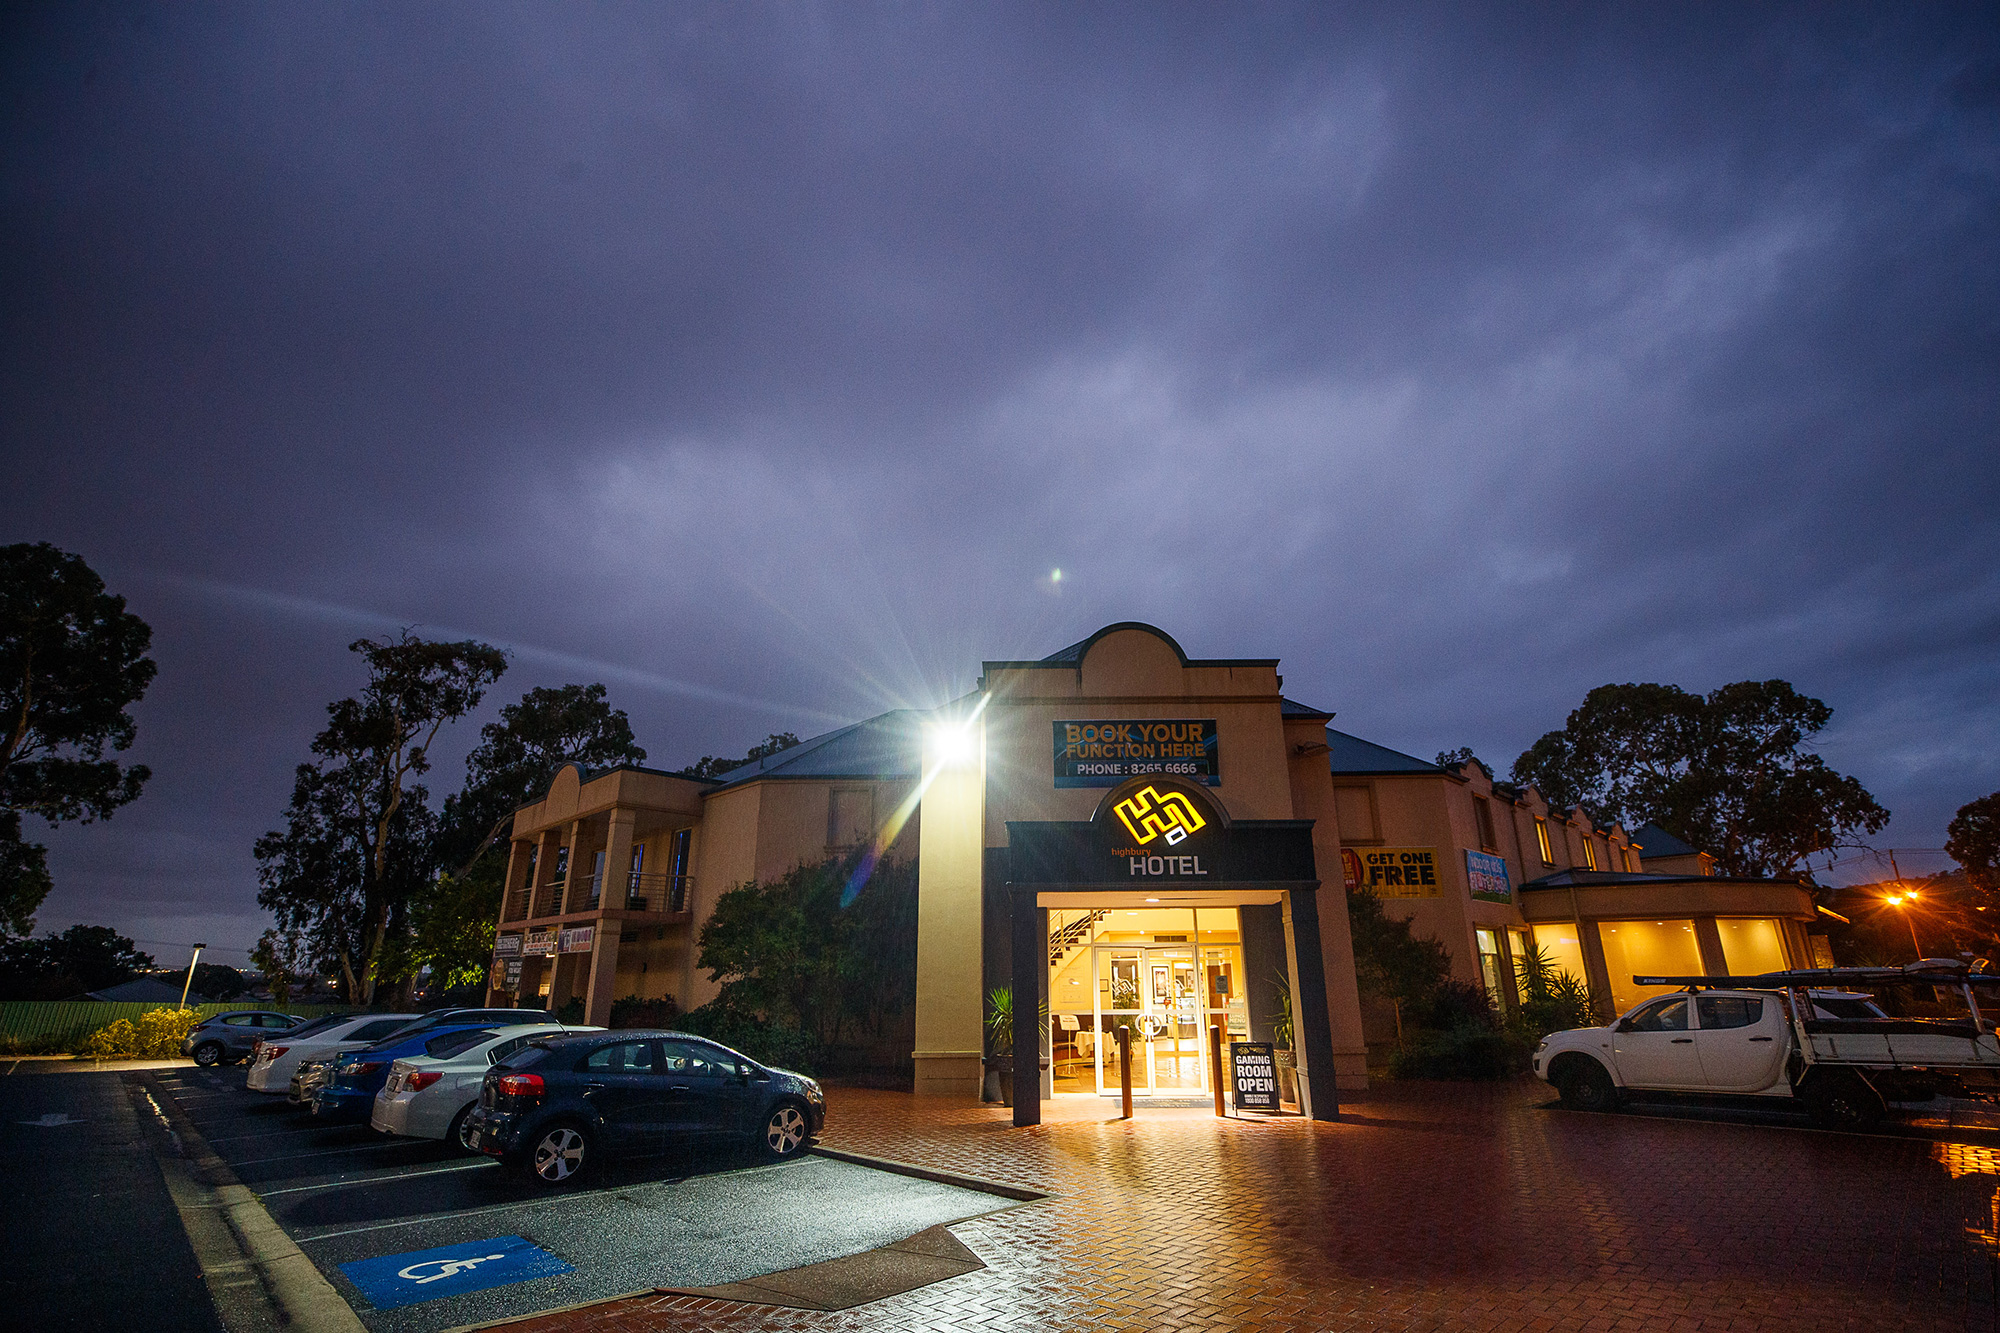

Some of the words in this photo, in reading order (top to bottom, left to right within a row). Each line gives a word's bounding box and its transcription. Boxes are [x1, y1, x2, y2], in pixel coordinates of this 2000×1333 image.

[1066, 724, 1133, 743] BOOK
[1138, 723, 1203, 743] YOUR
[1066, 743, 1156, 758] FUNCTION
[1160, 743, 1206, 757] HERE
[1077, 764, 1121, 775] PHONE
[1131, 763, 1162, 774] 8265
[1165, 763, 1197, 774] 6666
[1111, 847, 1151, 857] highbury
[1366, 853, 1395, 864] GET
[1400, 852, 1432, 864] ONE
[1129, 856, 1208, 875] HOTEL
[1369, 865, 1436, 885] FREE
[1236, 1055, 1271, 1065] GAMING
[1236, 1065, 1272, 1077] ROOM
[1238, 1078, 1274, 1092] OPEN
